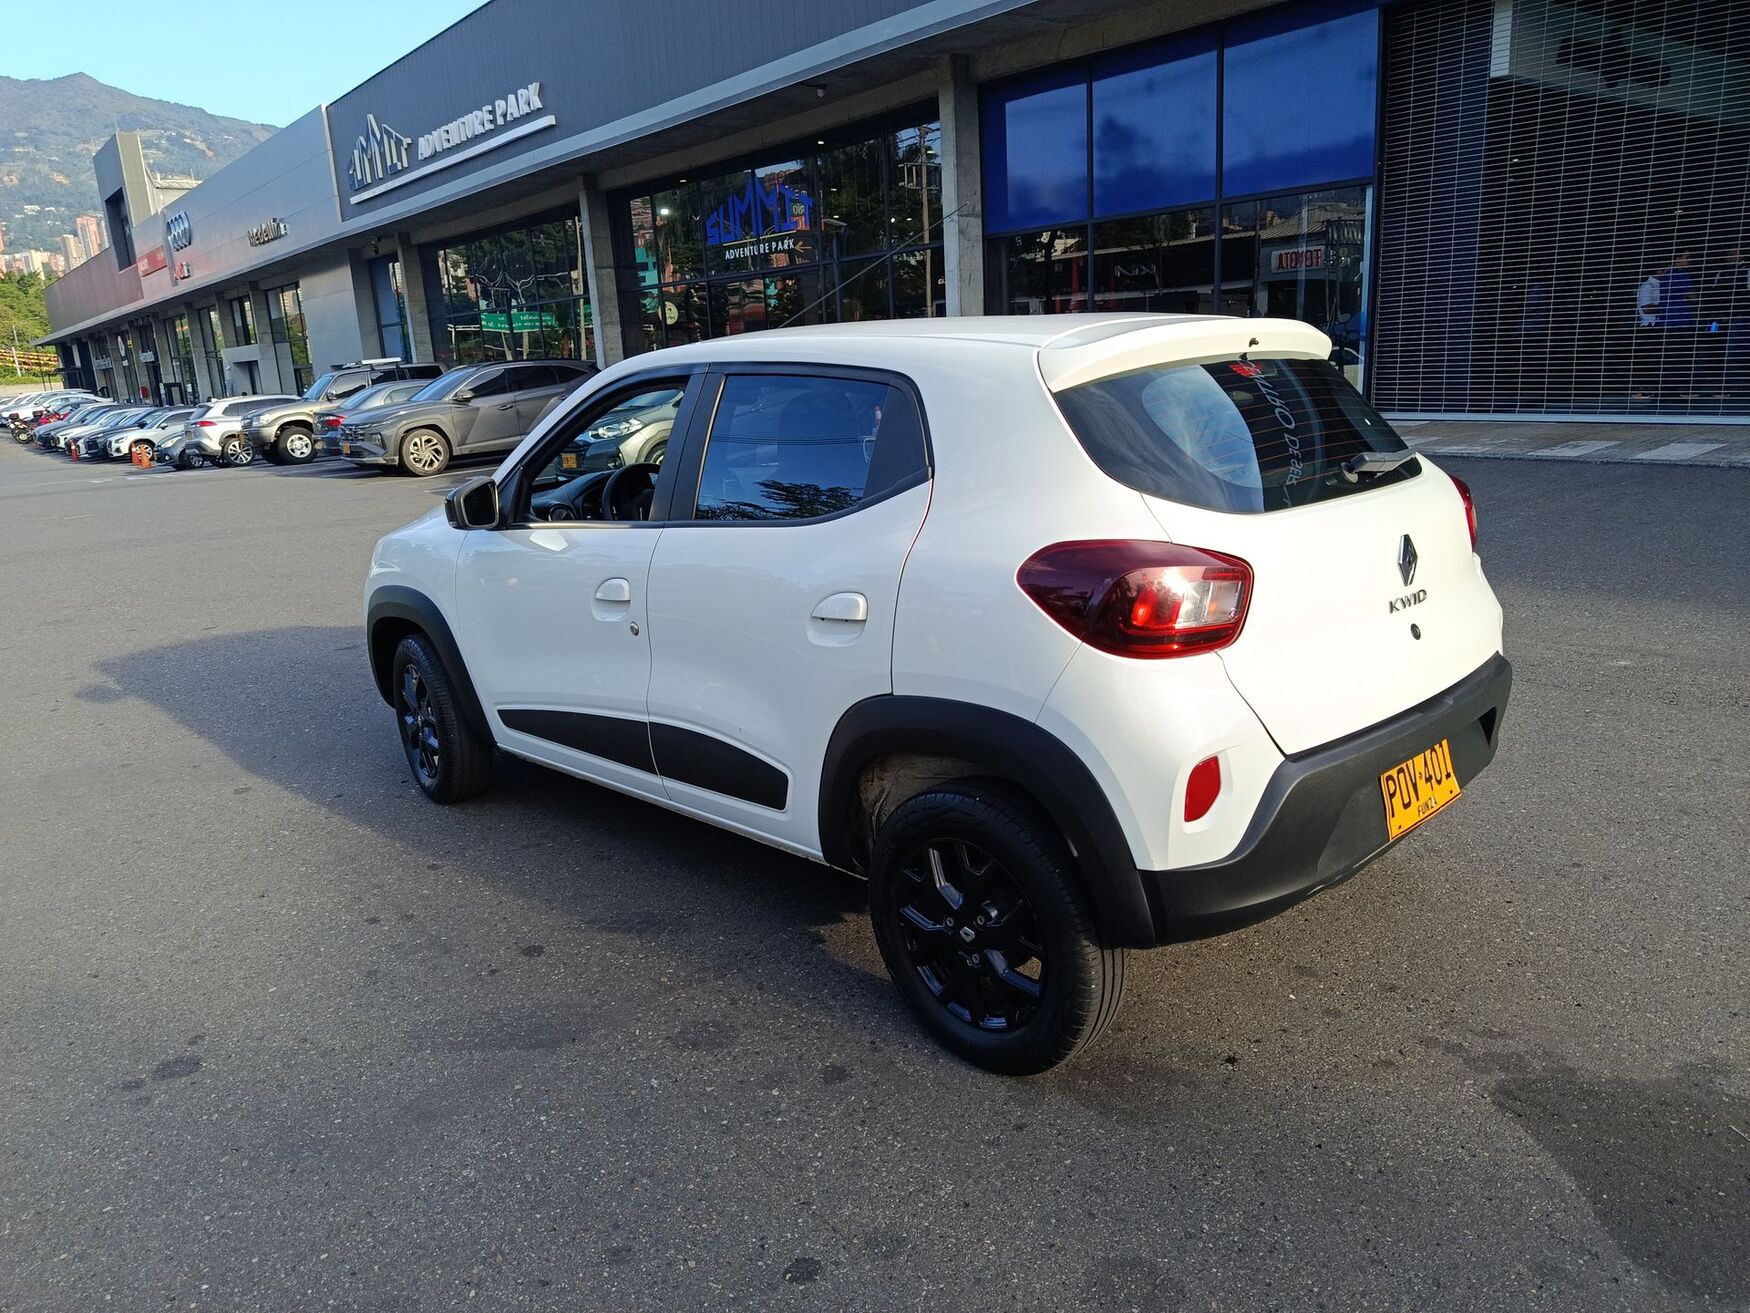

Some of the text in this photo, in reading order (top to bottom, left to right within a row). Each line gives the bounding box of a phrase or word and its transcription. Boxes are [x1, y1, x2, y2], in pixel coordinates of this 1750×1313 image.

[418, 82, 543, 160] ADVENTURE PARK
[706, 170, 814, 247] SUMMIT
[725, 238, 795, 260] ADVENTURE PARK
[1389, 589, 1427, 614] KWID
